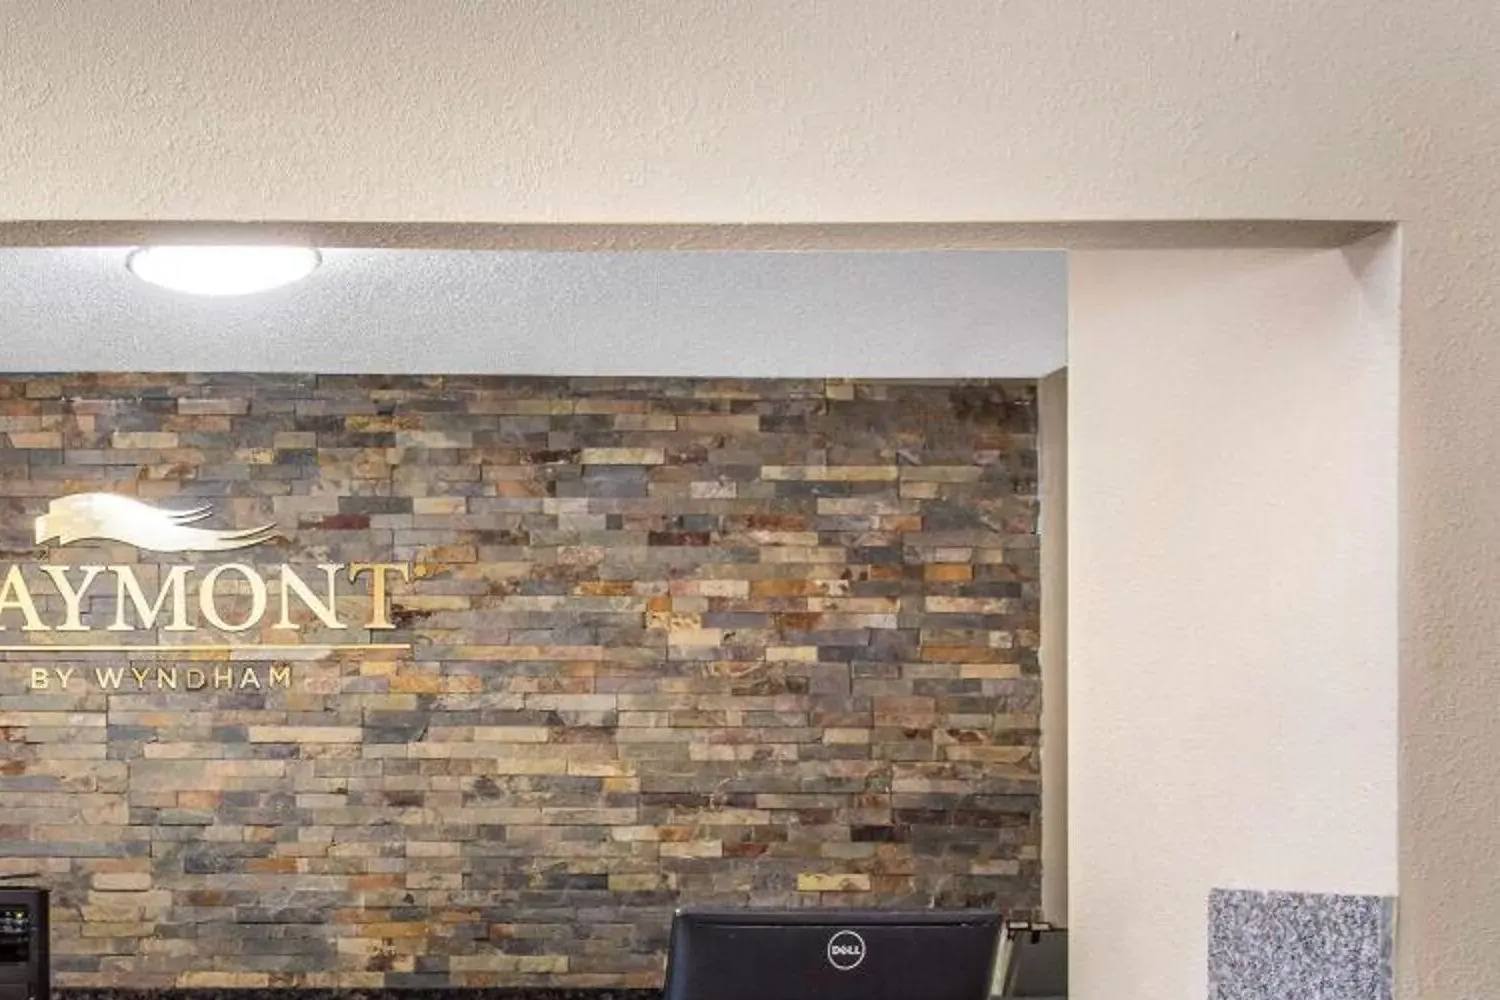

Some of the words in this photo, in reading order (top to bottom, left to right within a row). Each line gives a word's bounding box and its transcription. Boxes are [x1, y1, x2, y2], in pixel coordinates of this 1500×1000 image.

[31, 667, 74, 689] BY
[96, 666, 292, 691] WYNDHAM
[831, 944, 861, 955] DELL
